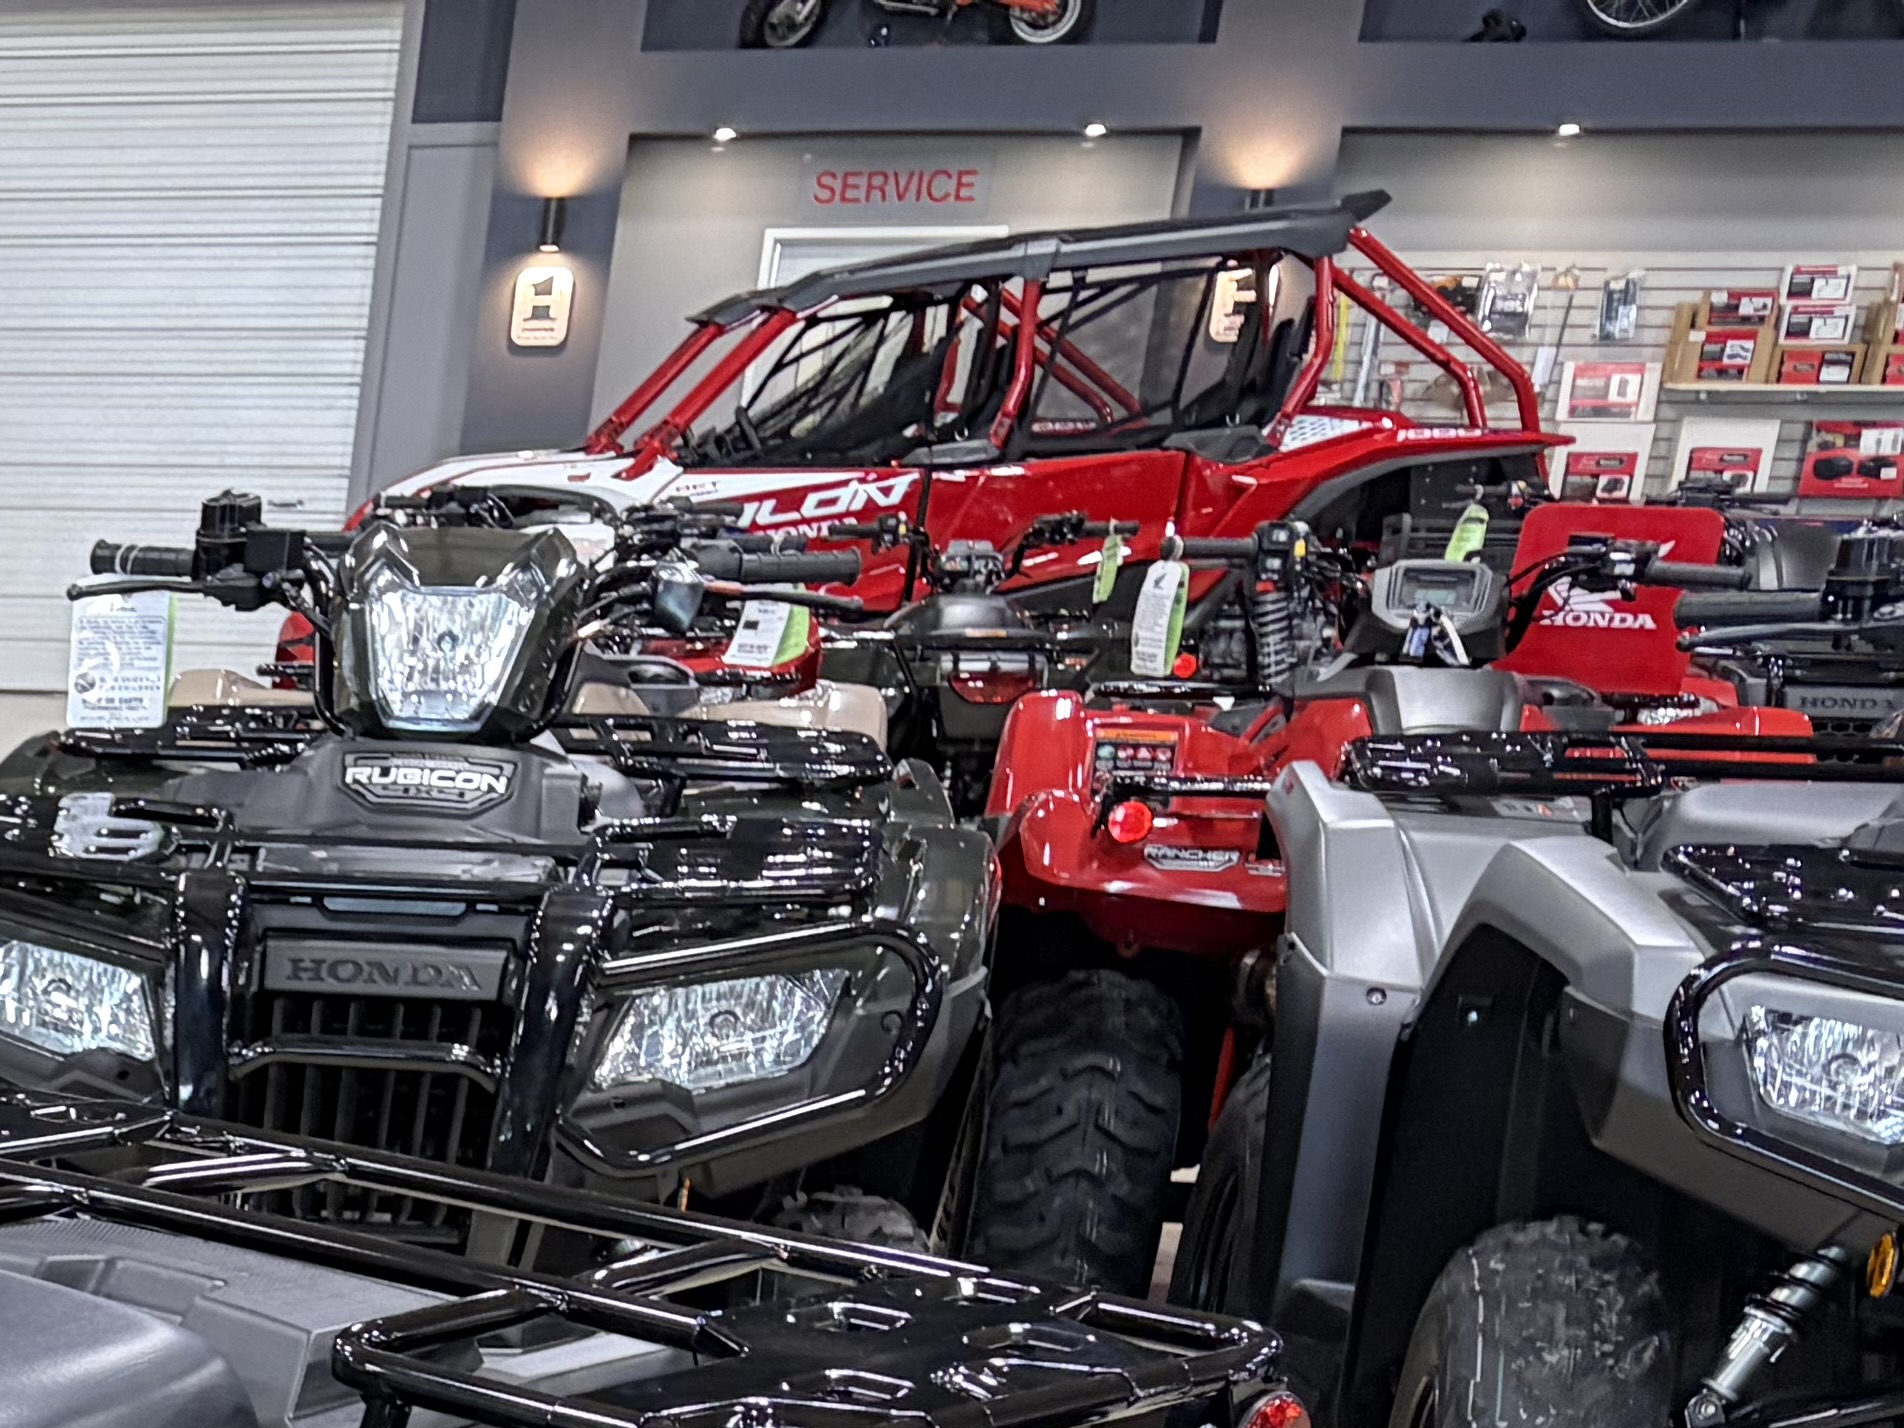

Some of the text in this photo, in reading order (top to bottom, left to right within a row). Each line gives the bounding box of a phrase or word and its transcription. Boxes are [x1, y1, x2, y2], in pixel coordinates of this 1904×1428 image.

[813, 169, 980, 205] SERVICE
[1539, 609, 1657, 630] HONDA
[344, 766, 508, 794] RUBICON
[286, 957, 482, 992] HONDA
